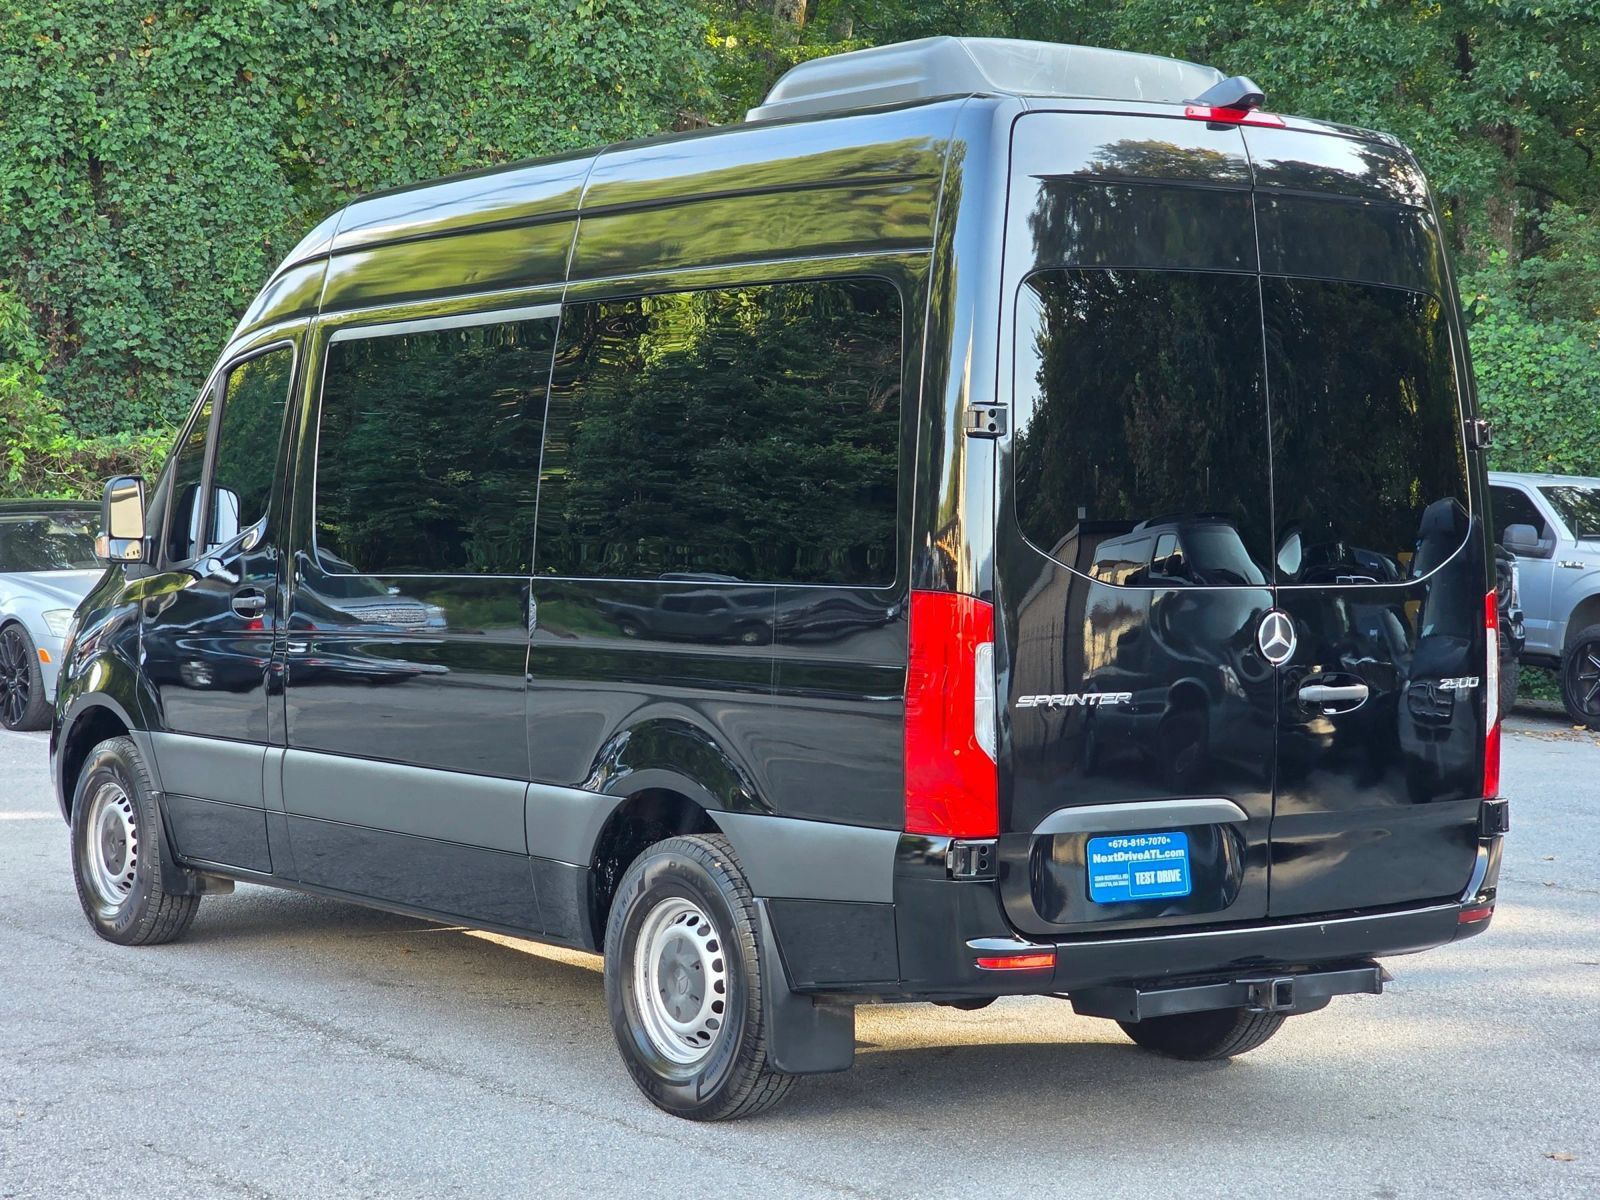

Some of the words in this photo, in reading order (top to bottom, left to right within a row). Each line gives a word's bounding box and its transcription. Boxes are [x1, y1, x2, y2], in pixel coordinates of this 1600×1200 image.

[1438, 677, 1480, 690] 2500
[1015, 691, 1133, 708] SPRINTER
[1113, 836, 1167, 849] 678-819-7070
[1092, 849, 1185, 864] NextDriveATL.com
[1134, 871, 1156, 885] TEST
[1157, 869, 1182, 884] DRIVE
